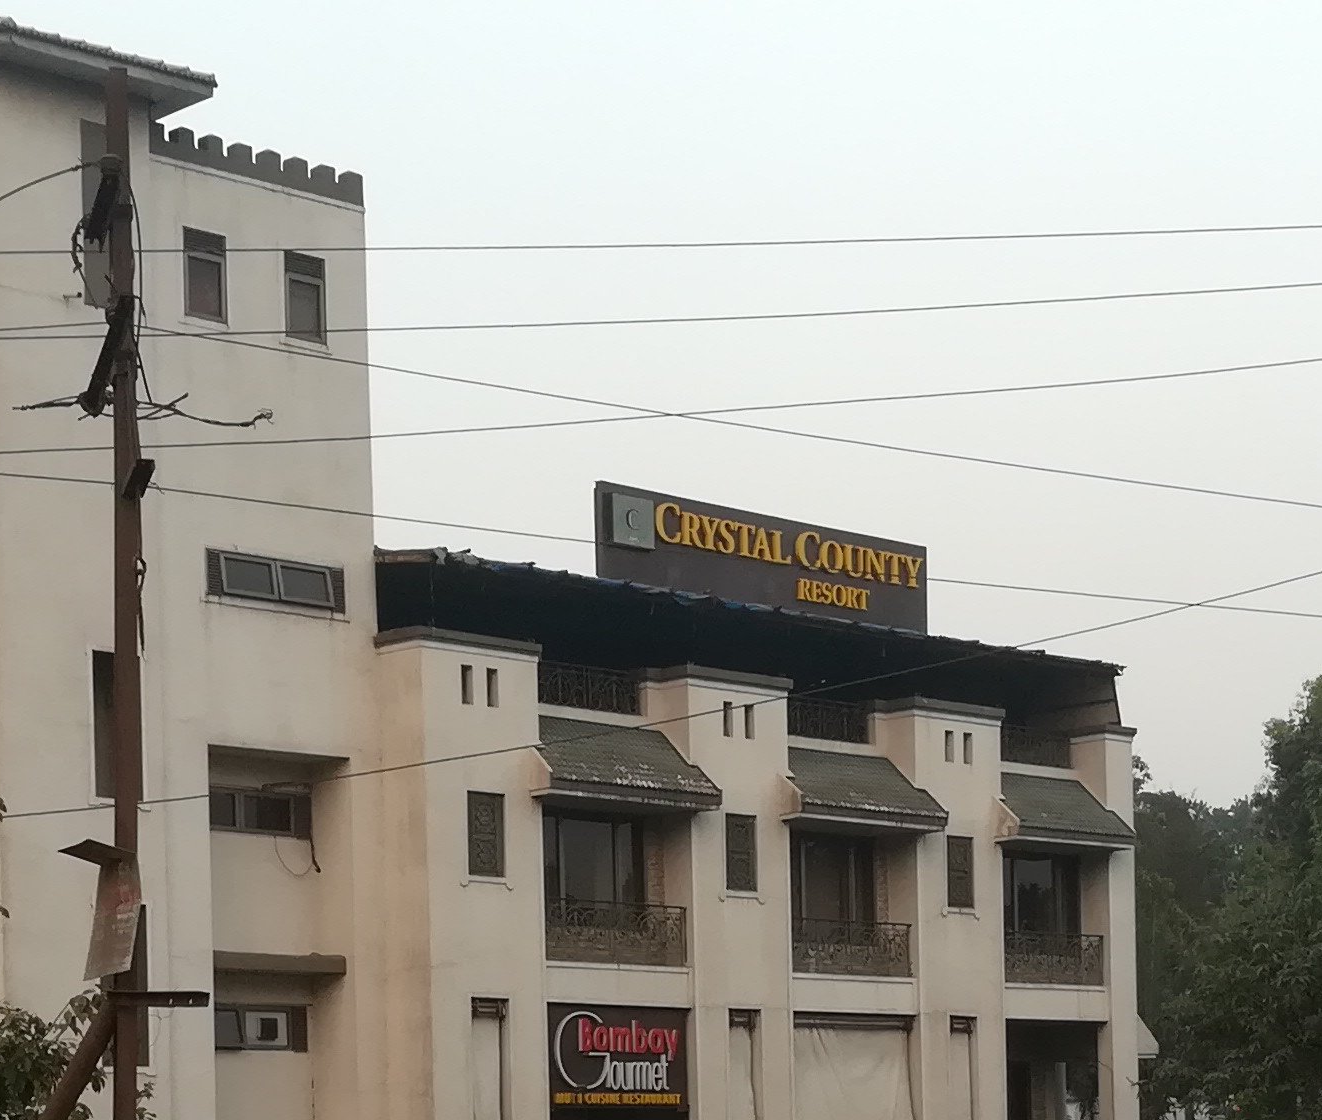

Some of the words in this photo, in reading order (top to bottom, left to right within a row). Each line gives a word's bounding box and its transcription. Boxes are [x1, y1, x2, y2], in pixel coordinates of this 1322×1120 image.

[655, 502, 792, 566] CRYSTAL
[795, 531, 925, 589] COUNTY
[796, 578, 870, 611] RESORT
[554, 1010, 670, 1091] Gourmet
[578, 1017, 679, 1061] Bombay
